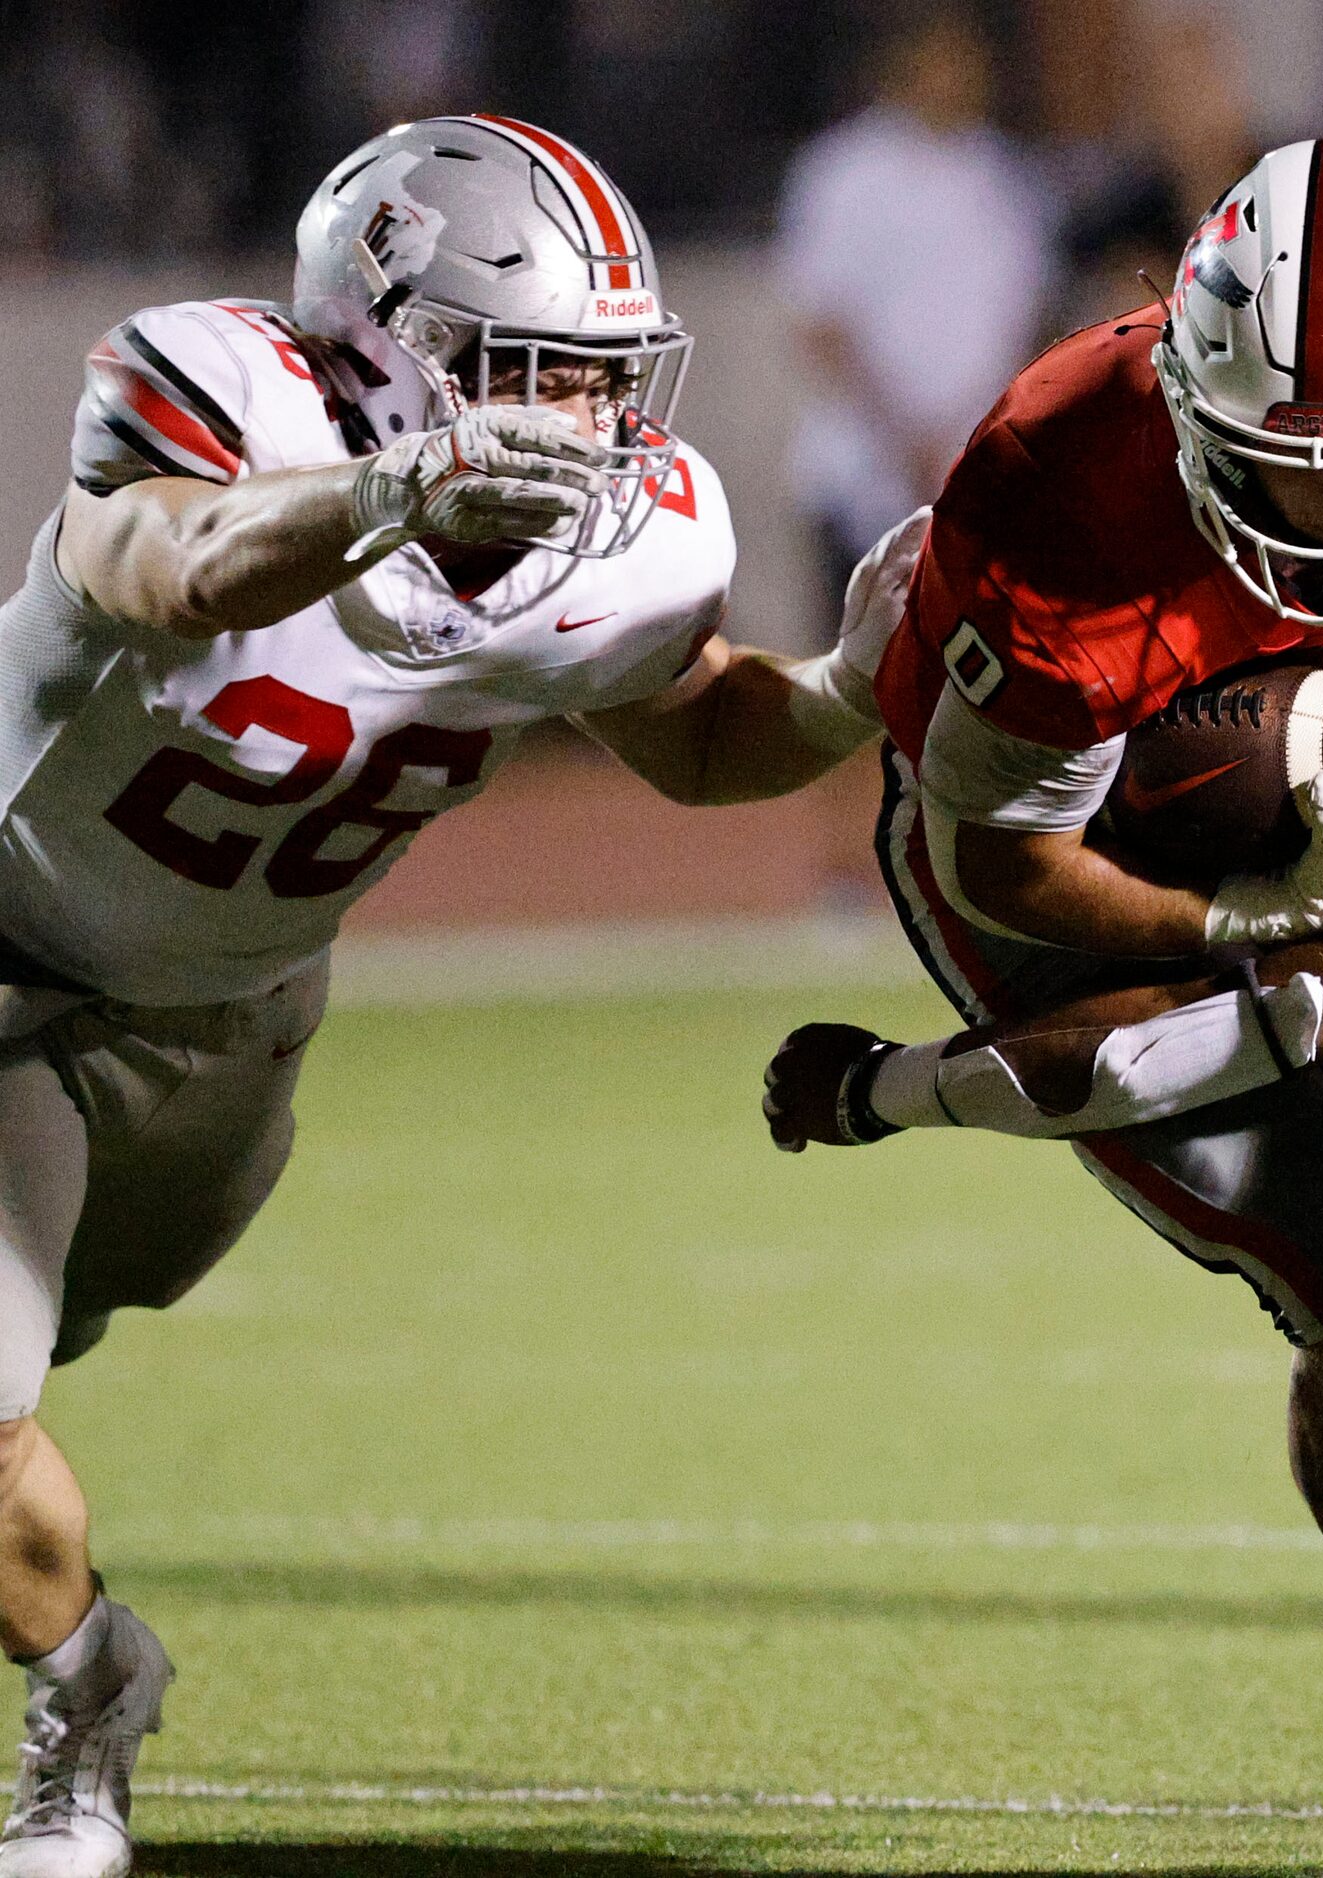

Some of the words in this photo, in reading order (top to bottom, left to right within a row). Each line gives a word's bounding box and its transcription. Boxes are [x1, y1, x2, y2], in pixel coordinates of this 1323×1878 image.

[596, 296, 653, 317] Riddell
[944, 620, 1004, 706] 0
[102, 673, 493, 898] 26
